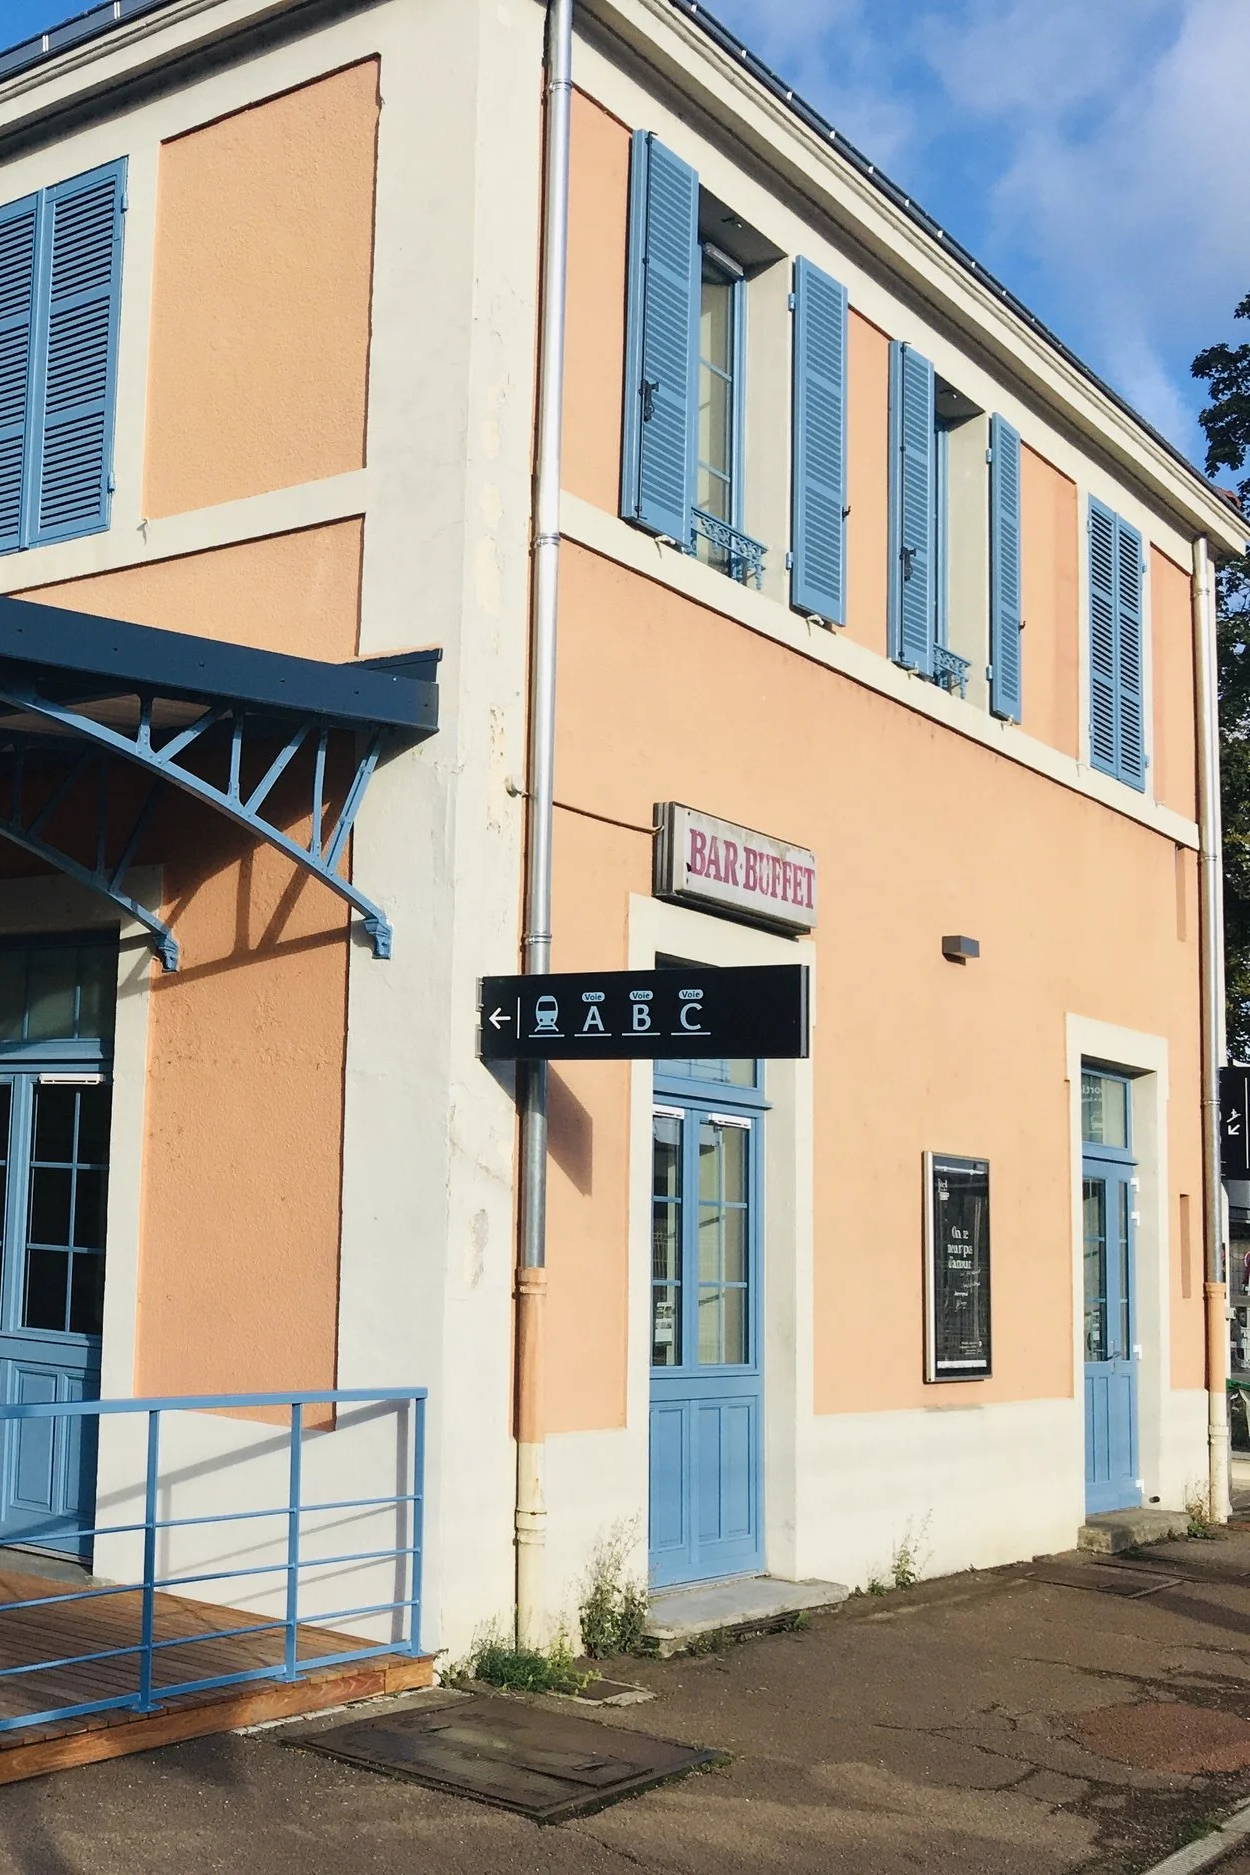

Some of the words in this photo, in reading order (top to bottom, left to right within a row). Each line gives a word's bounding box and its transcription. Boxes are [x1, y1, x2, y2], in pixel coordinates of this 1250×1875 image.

[689, 828, 739, 887] BAR
[743, 846, 815, 909] BUFFET
[584, 992, 602, 1001] Voie
[632, 991, 650, 1000] Voie
[682, 990, 700, 999] Voie
[582, 1005, 605, 1031] A
[632, 1004, 651, 1031] B
[680, 1002, 703, 1030] C
